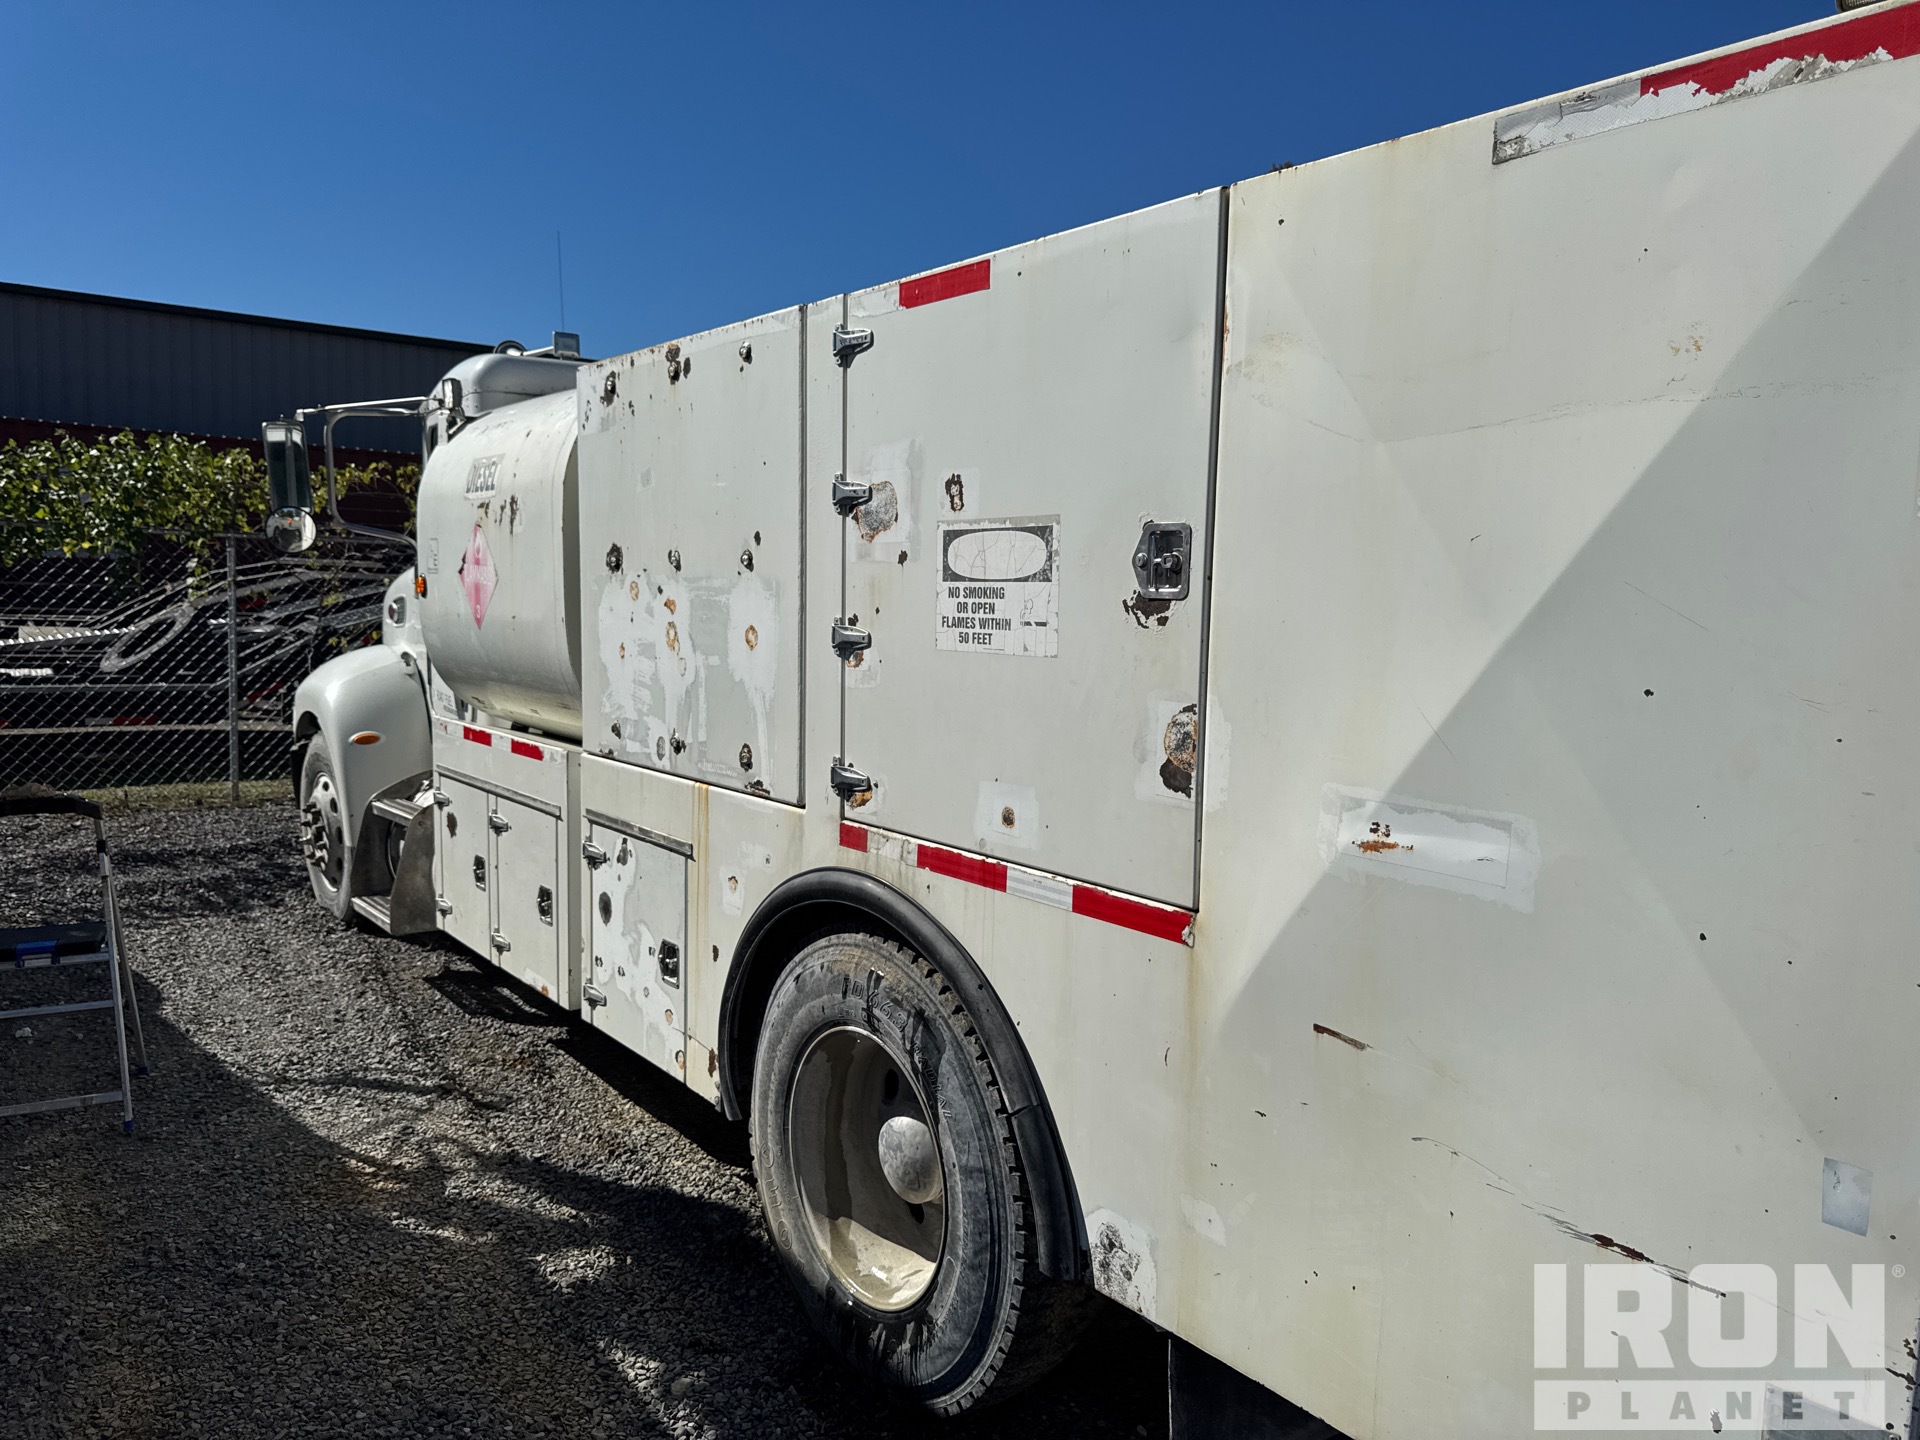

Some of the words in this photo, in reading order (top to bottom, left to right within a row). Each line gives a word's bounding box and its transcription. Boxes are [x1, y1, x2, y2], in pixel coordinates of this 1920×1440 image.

[465, 461, 499, 494] DIESEL
[464, 566, 496, 585] LAMMABLE
[948, 586, 961, 599] NO
[962, 586, 1005, 600] SMOKING
[475, 604, 481, 618] 3
[956, 601, 969, 614] OR
[971, 602, 995, 615] OPEN
[941, 616, 976, 630] FLAMES
[978, 617, 1011, 631] WITHIN
[958, 632, 970, 644] 50
[972, 632, 993, 645] FEET
